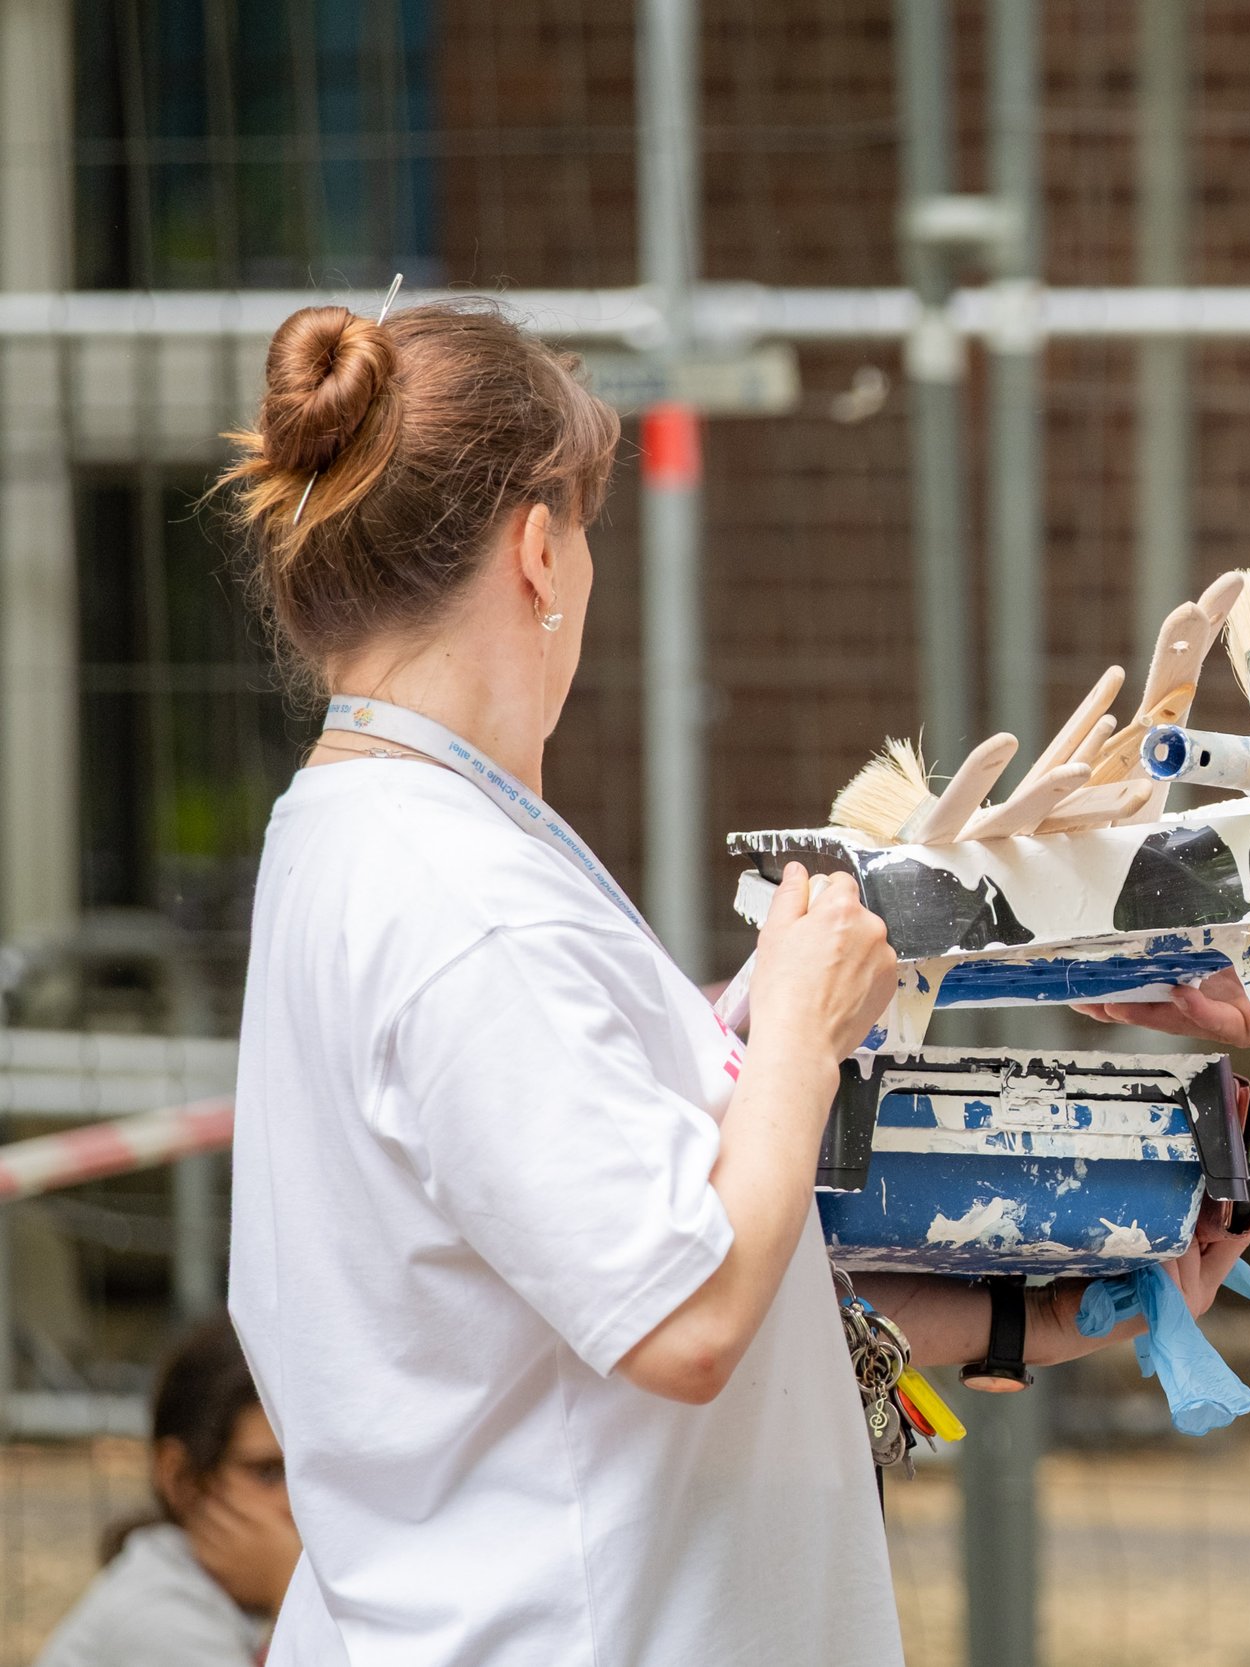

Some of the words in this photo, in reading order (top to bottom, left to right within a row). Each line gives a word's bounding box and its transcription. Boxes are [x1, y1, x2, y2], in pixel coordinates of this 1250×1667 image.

[448, 741, 471, 760] alle!
[471, 758, 485, 774] für
[487, 770, 518, 801] Schule
[519, 798, 541, 820] Eine
[546, 822, 595, 871] füreinander
